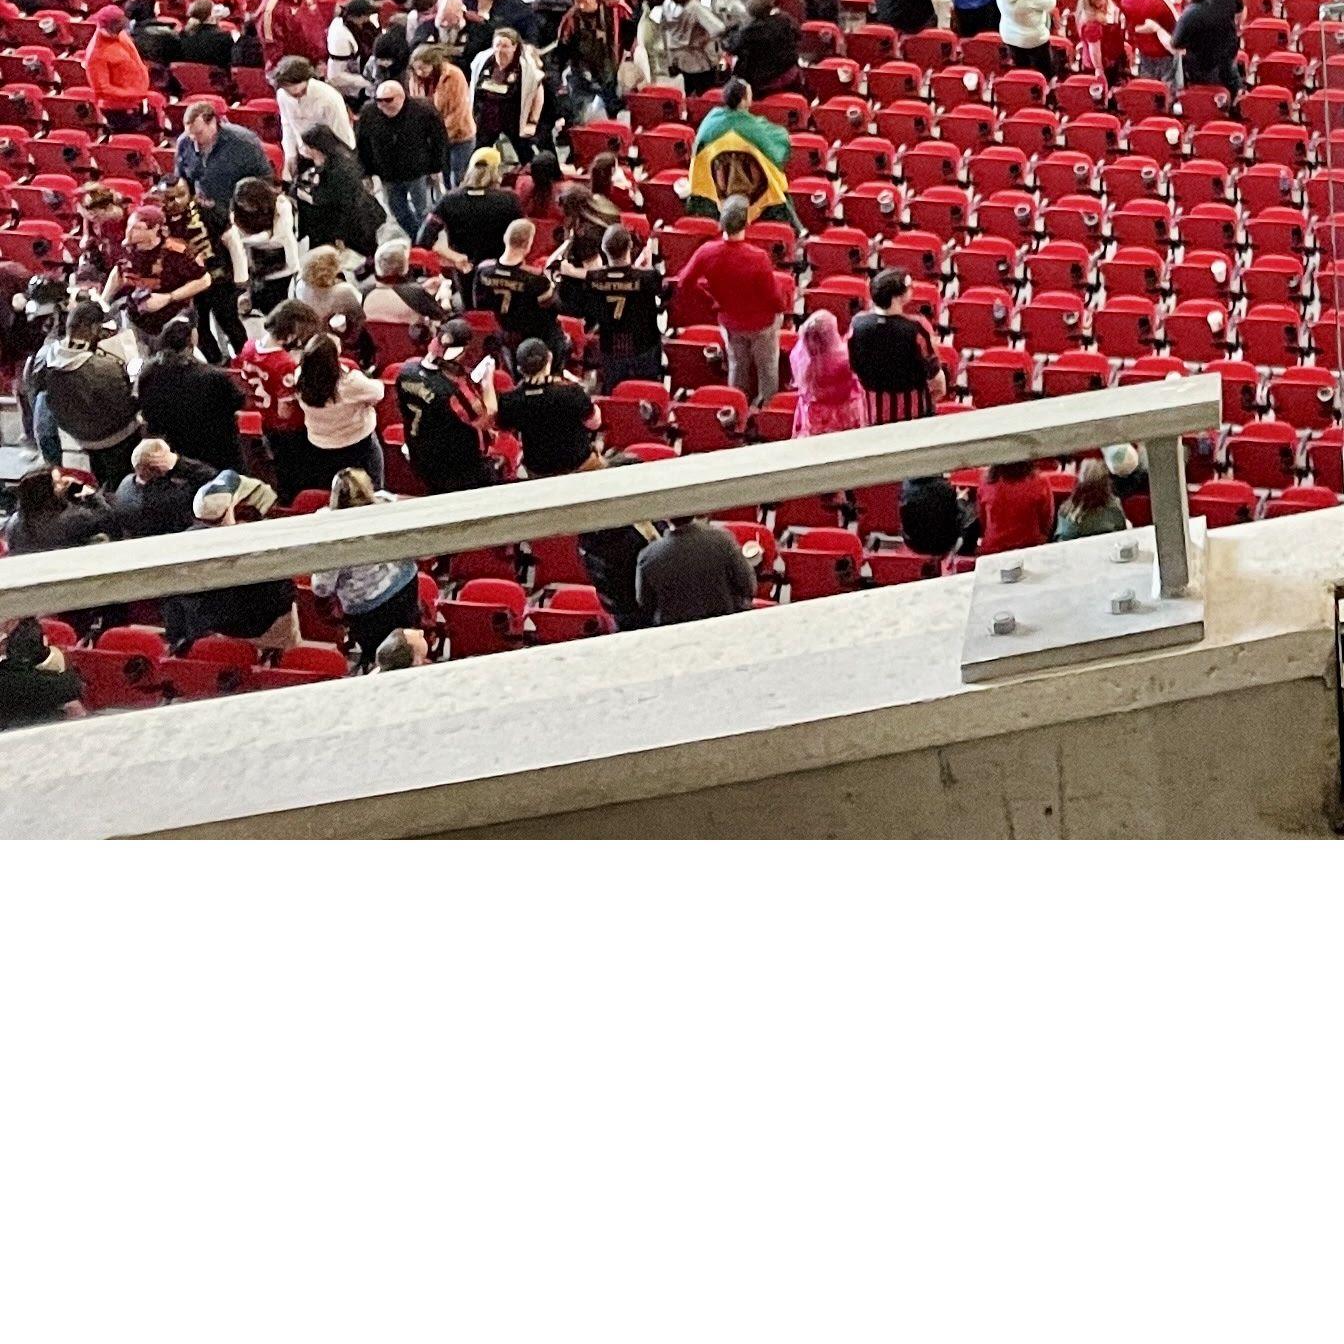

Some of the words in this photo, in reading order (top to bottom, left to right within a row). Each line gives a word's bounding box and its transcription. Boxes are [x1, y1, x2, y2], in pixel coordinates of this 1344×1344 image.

[493, 290, 512, 313] 7
[606, 296, 626, 321] 7
[406, 402, 423, 437] 7
